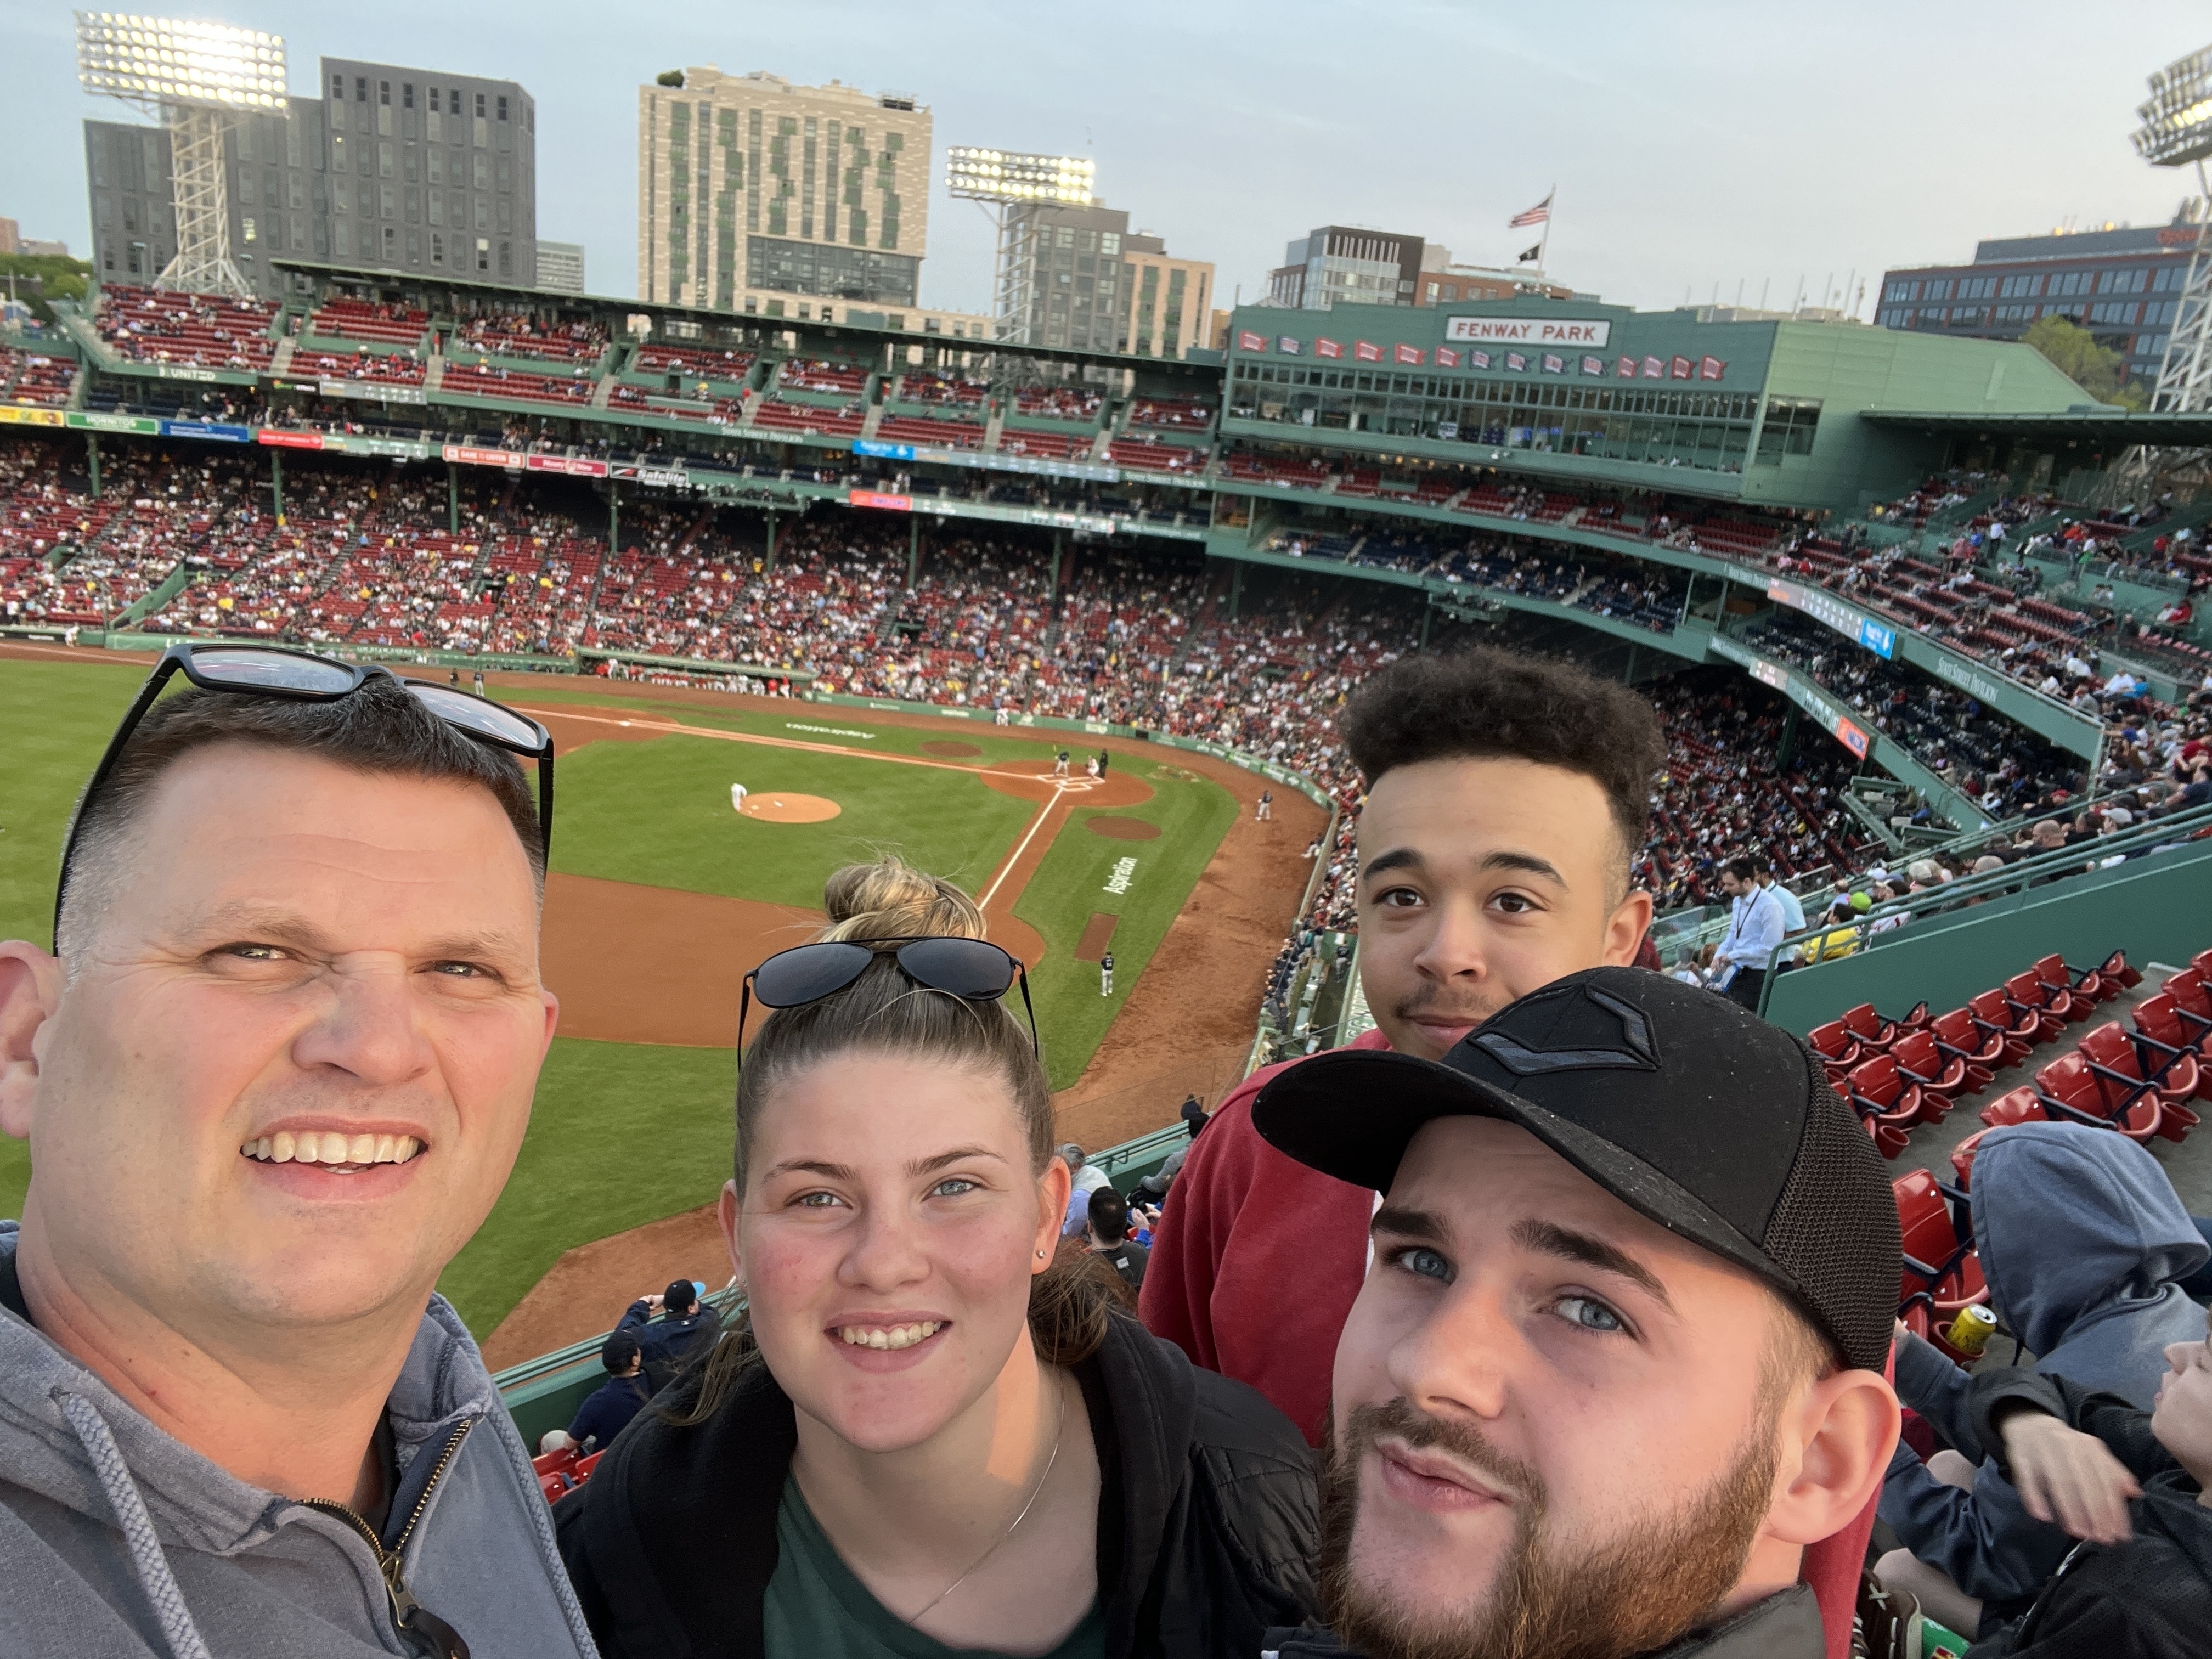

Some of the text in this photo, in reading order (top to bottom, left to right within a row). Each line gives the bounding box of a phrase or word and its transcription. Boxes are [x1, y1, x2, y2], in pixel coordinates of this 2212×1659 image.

[1455, 322, 1596, 341] FENWAY PARK
[171, 367, 216, 381] UNITED
[637, 469, 685, 482] Safelite
[1103, 857, 1138, 894] Aspiration
